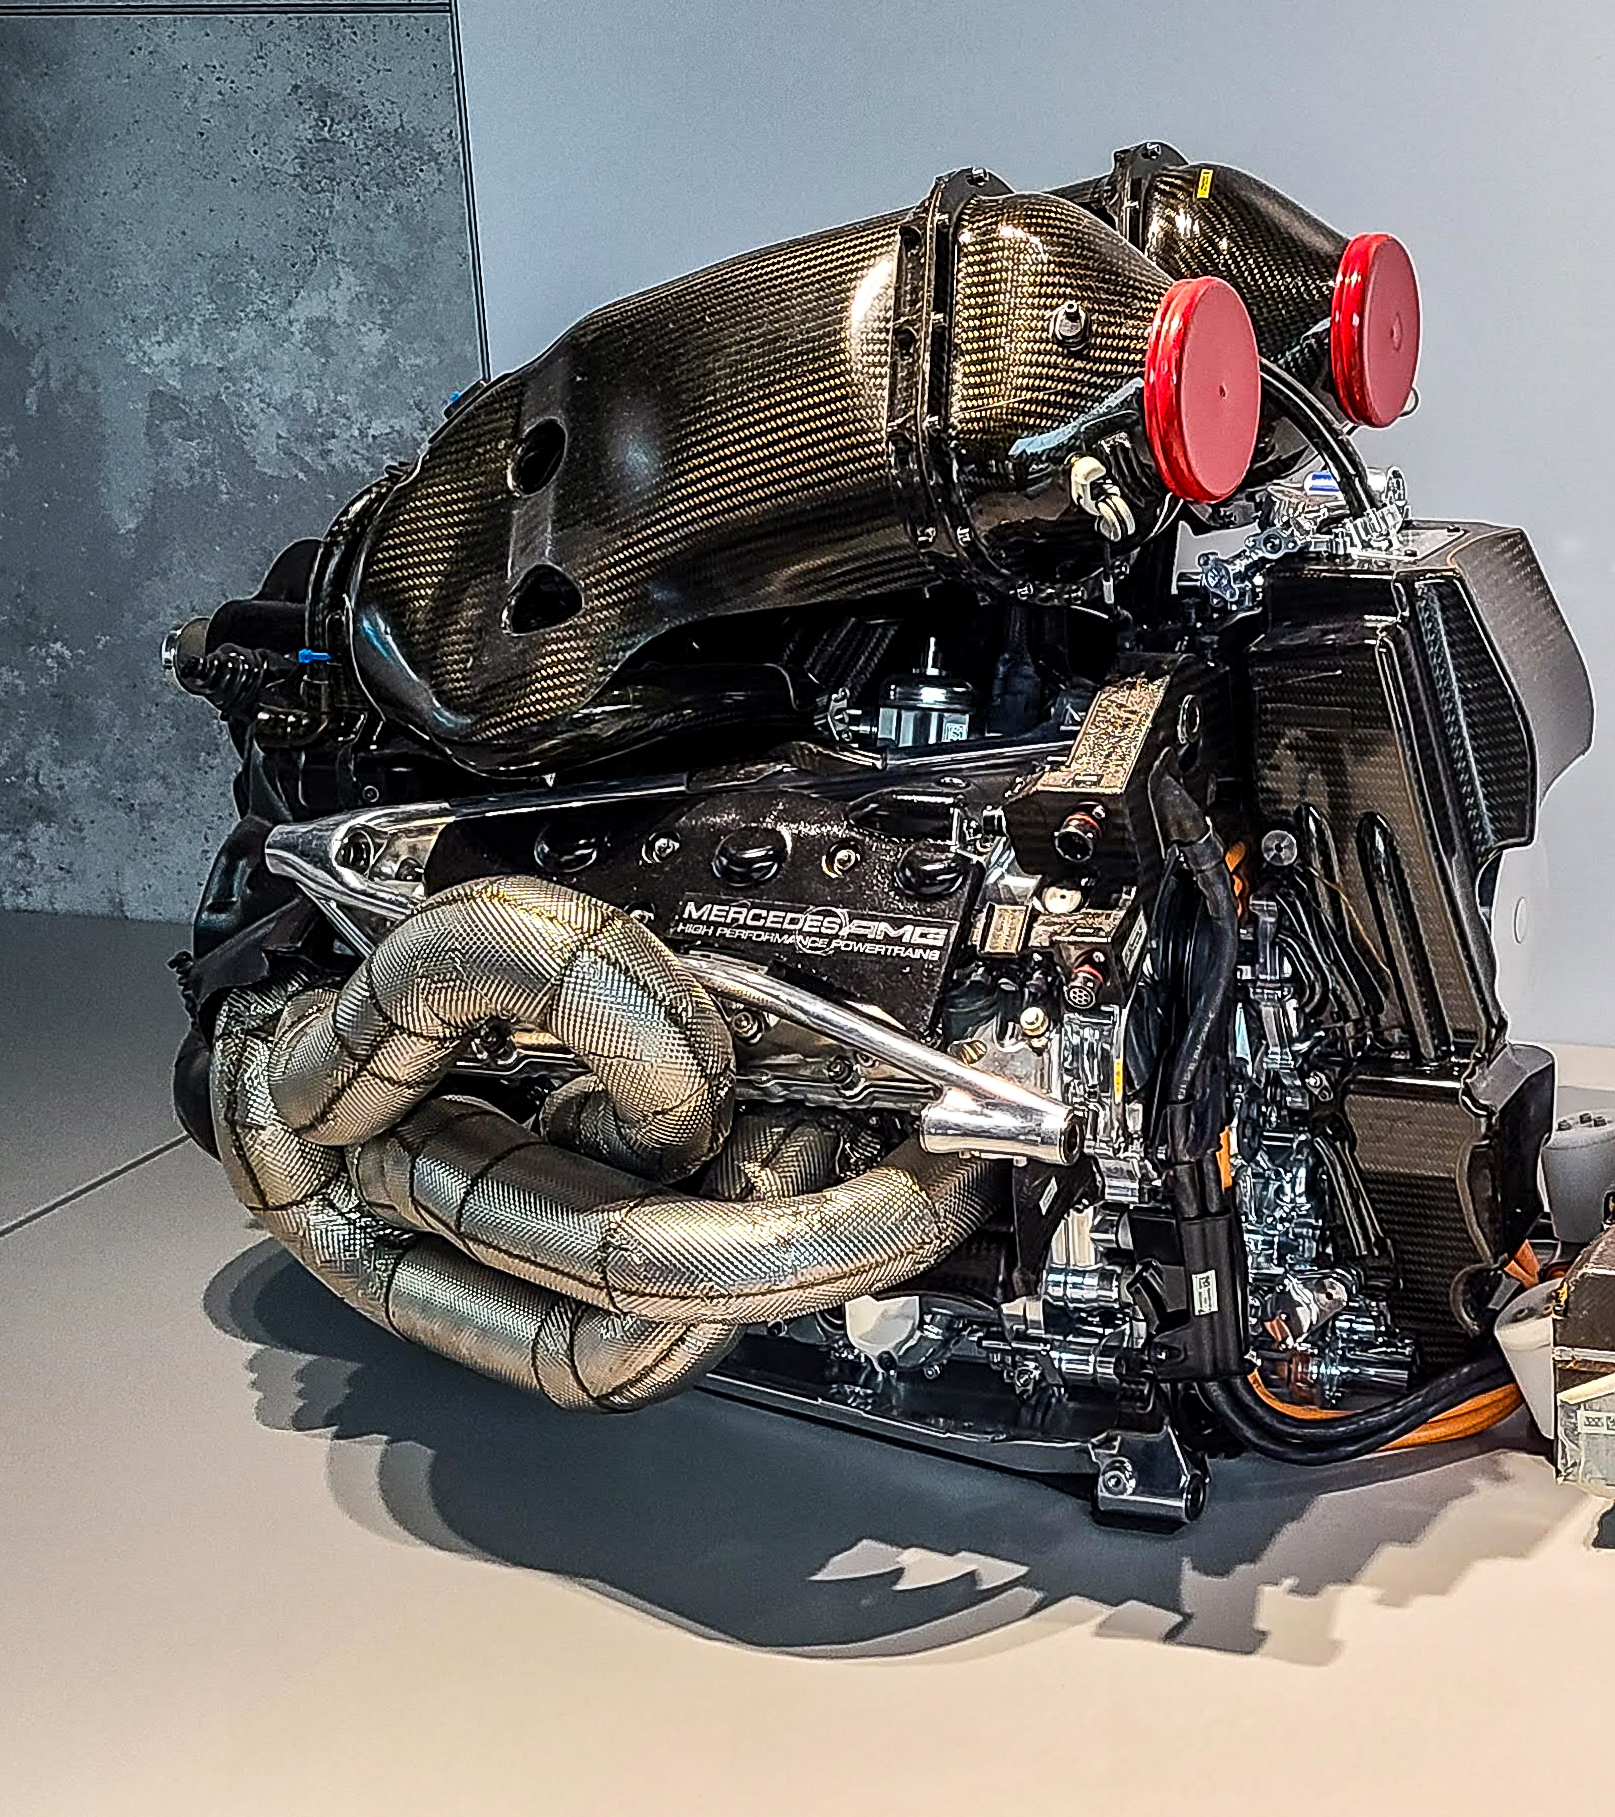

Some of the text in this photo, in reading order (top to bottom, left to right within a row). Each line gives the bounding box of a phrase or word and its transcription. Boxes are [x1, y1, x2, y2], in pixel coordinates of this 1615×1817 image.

[677, 922, 941, 961] HIGH PERFORMANCE POWERTRAINS
[683, 901, 949, 947] MERCEDES AMG
